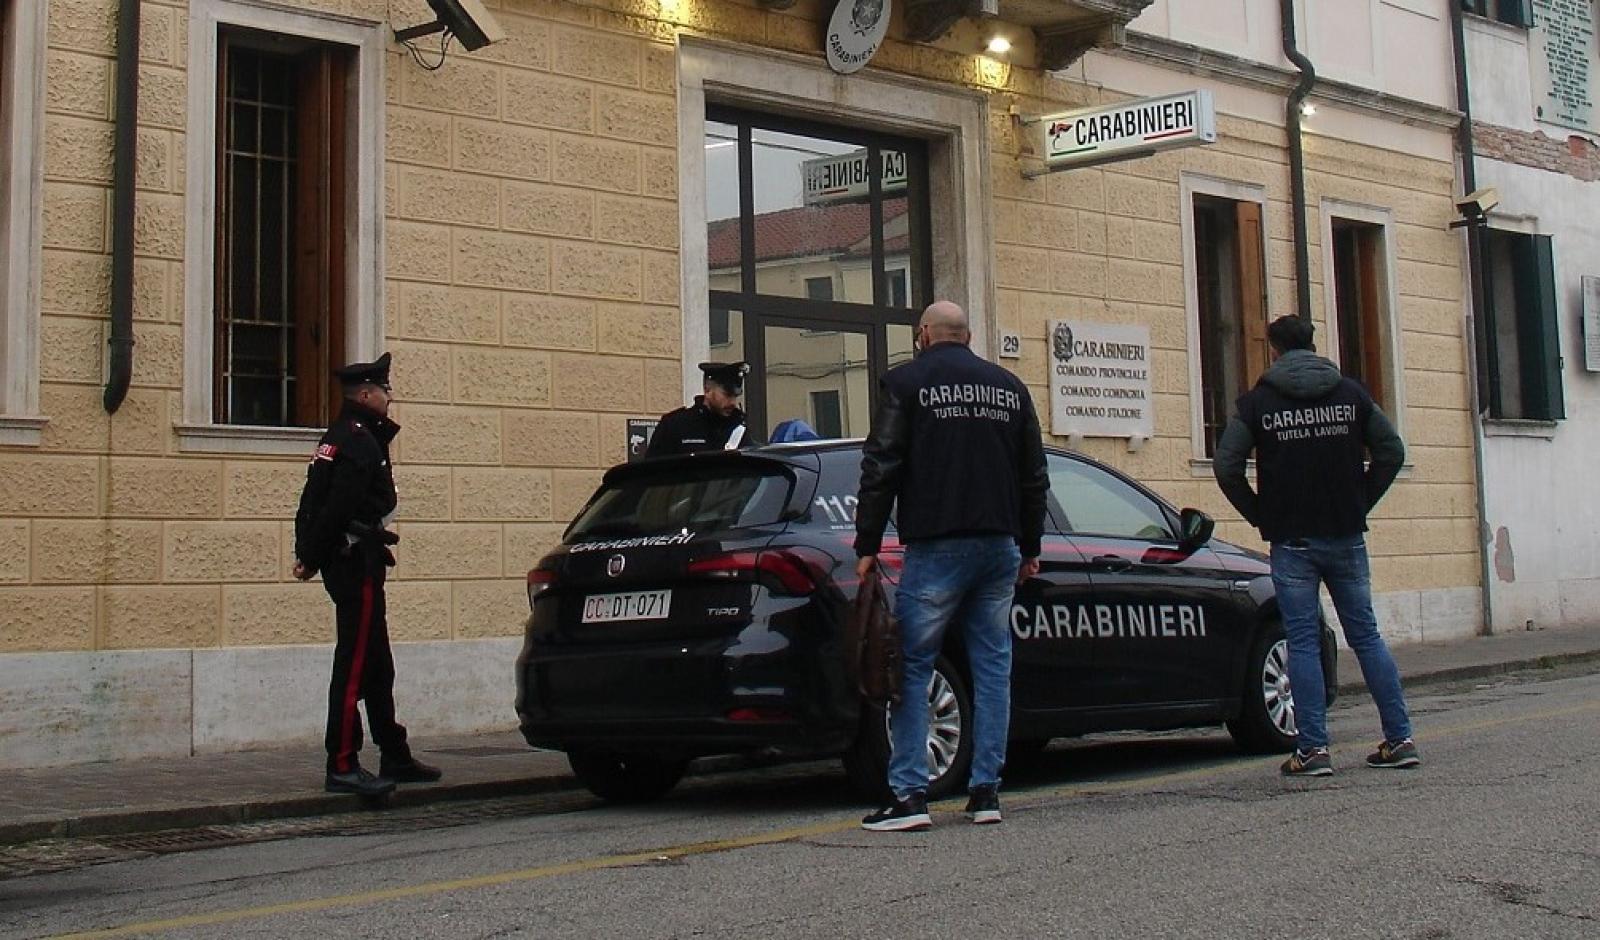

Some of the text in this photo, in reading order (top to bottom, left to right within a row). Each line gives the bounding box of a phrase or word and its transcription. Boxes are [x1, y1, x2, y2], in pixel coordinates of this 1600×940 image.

[829, 33, 876, 64] CARABINIERI
[1075, 99, 1194, 146] CARABINIERI
[1003, 335, 1020, 353] 29
[1073, 340, 1145, 361] CARABINIERI
[1056, 364, 1147, 380] COMANDO PROVINCIALE
[919, 384, 1020, 410] CARABINIERI
[1060, 385, 1101, 398] COMANDO
[934, 406, 1010, 422] TUTELA LAVORO
[1065, 405, 1143, 419] COMANDO STAZIONE
[1262, 404, 1356, 430] CARABINIERI
[1277, 425, 1349, 441] TUTELA LAVORO
[570, 531, 696, 554] CARABINIERI
[708, 607, 740, 616] TIPO
[1011, 604, 1207, 640] CARABINIERI
